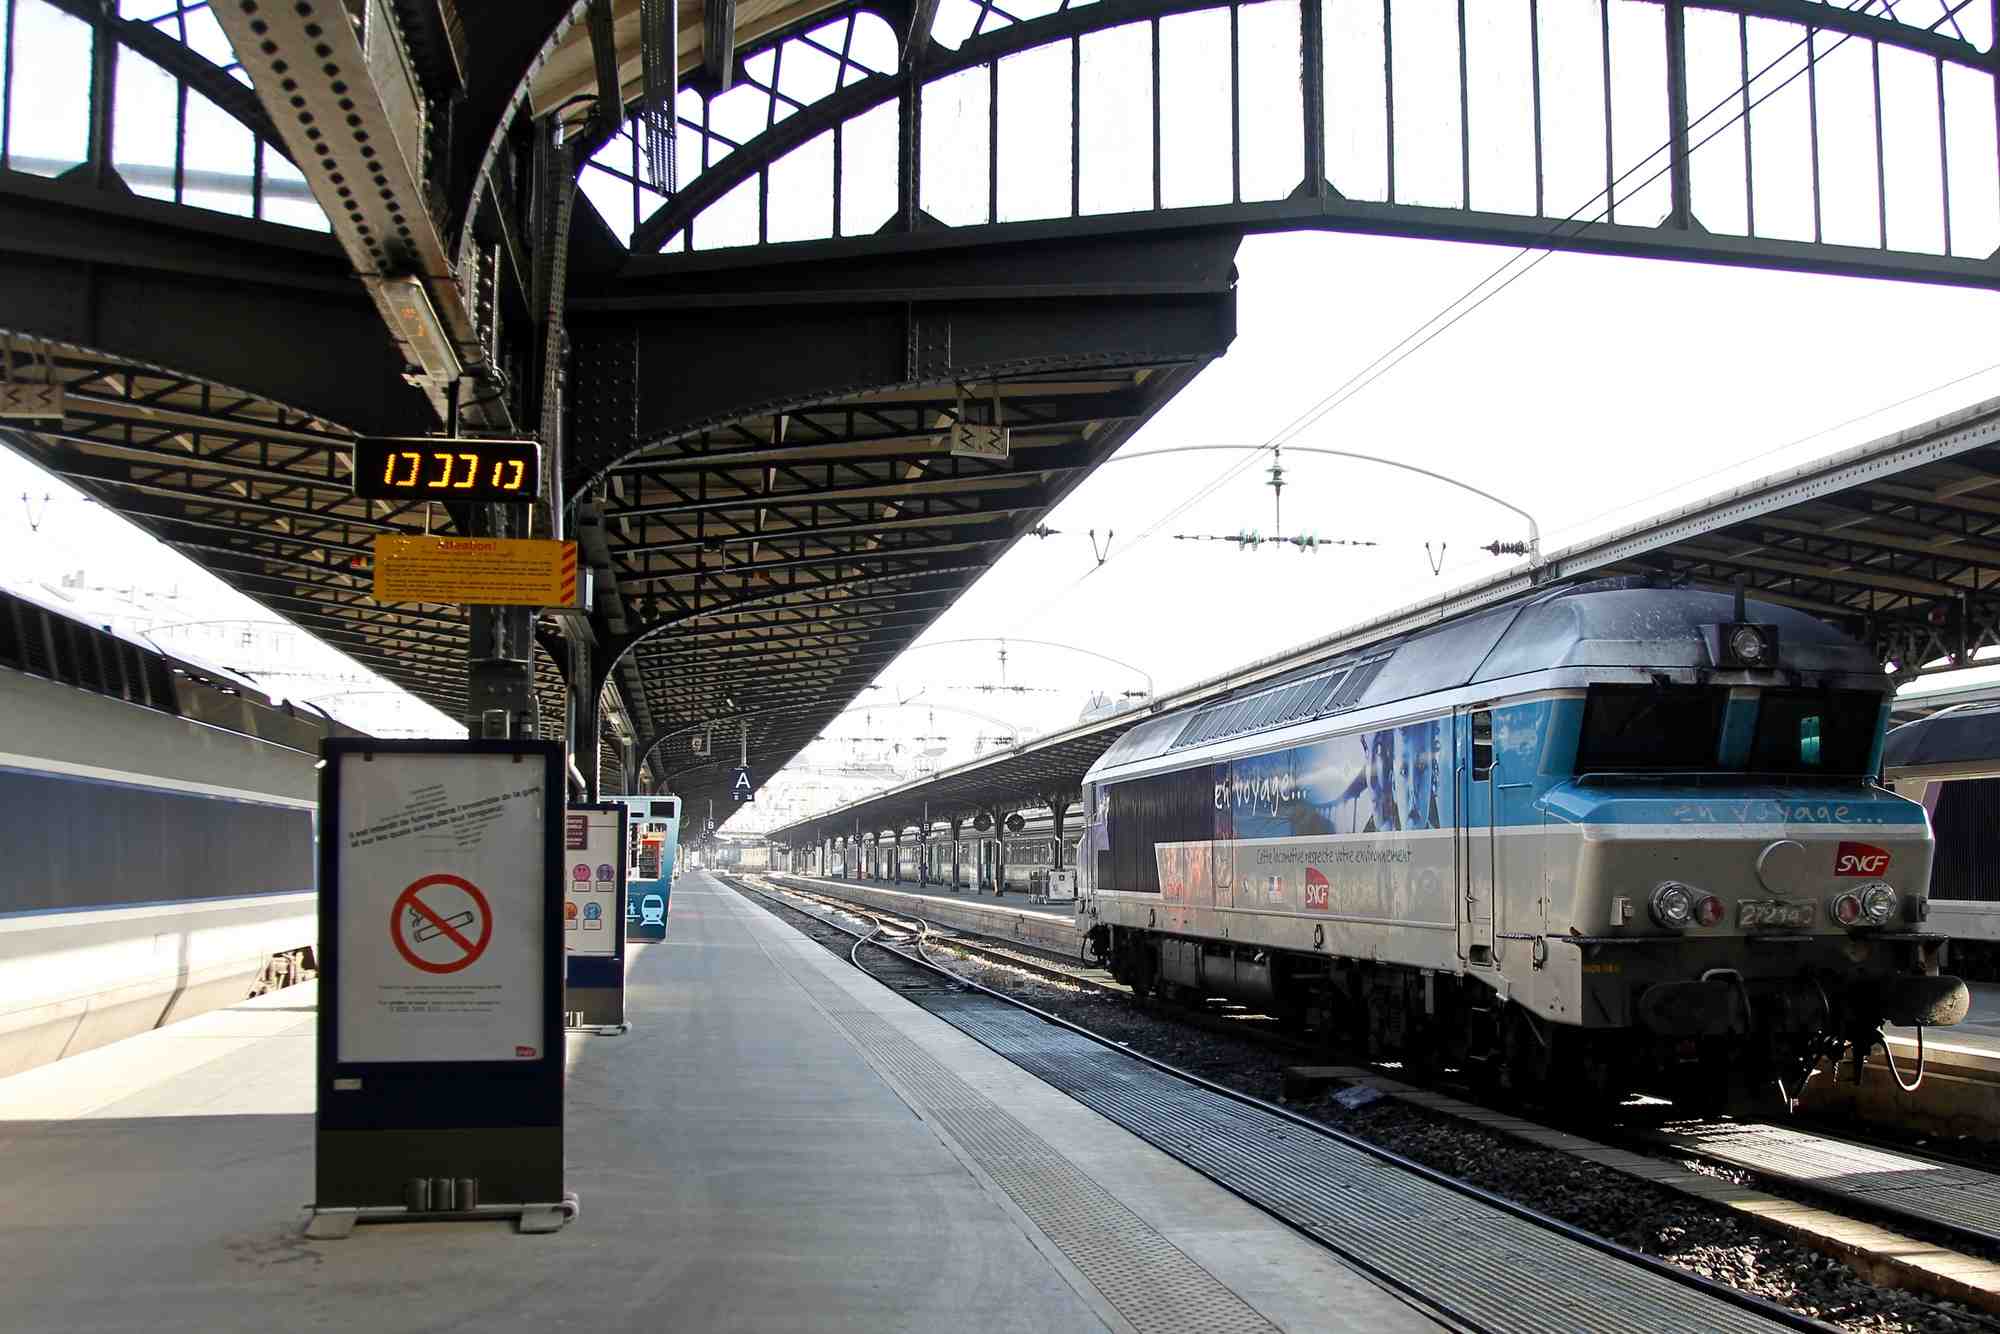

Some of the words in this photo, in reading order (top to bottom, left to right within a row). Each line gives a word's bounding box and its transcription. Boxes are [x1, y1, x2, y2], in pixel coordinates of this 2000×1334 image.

[735, 772, 751, 789] A
[1214, 779, 1232, 809] en
[1837, 855, 1888, 873] SNCF
[1305, 883, 1329, 904] SNCF
